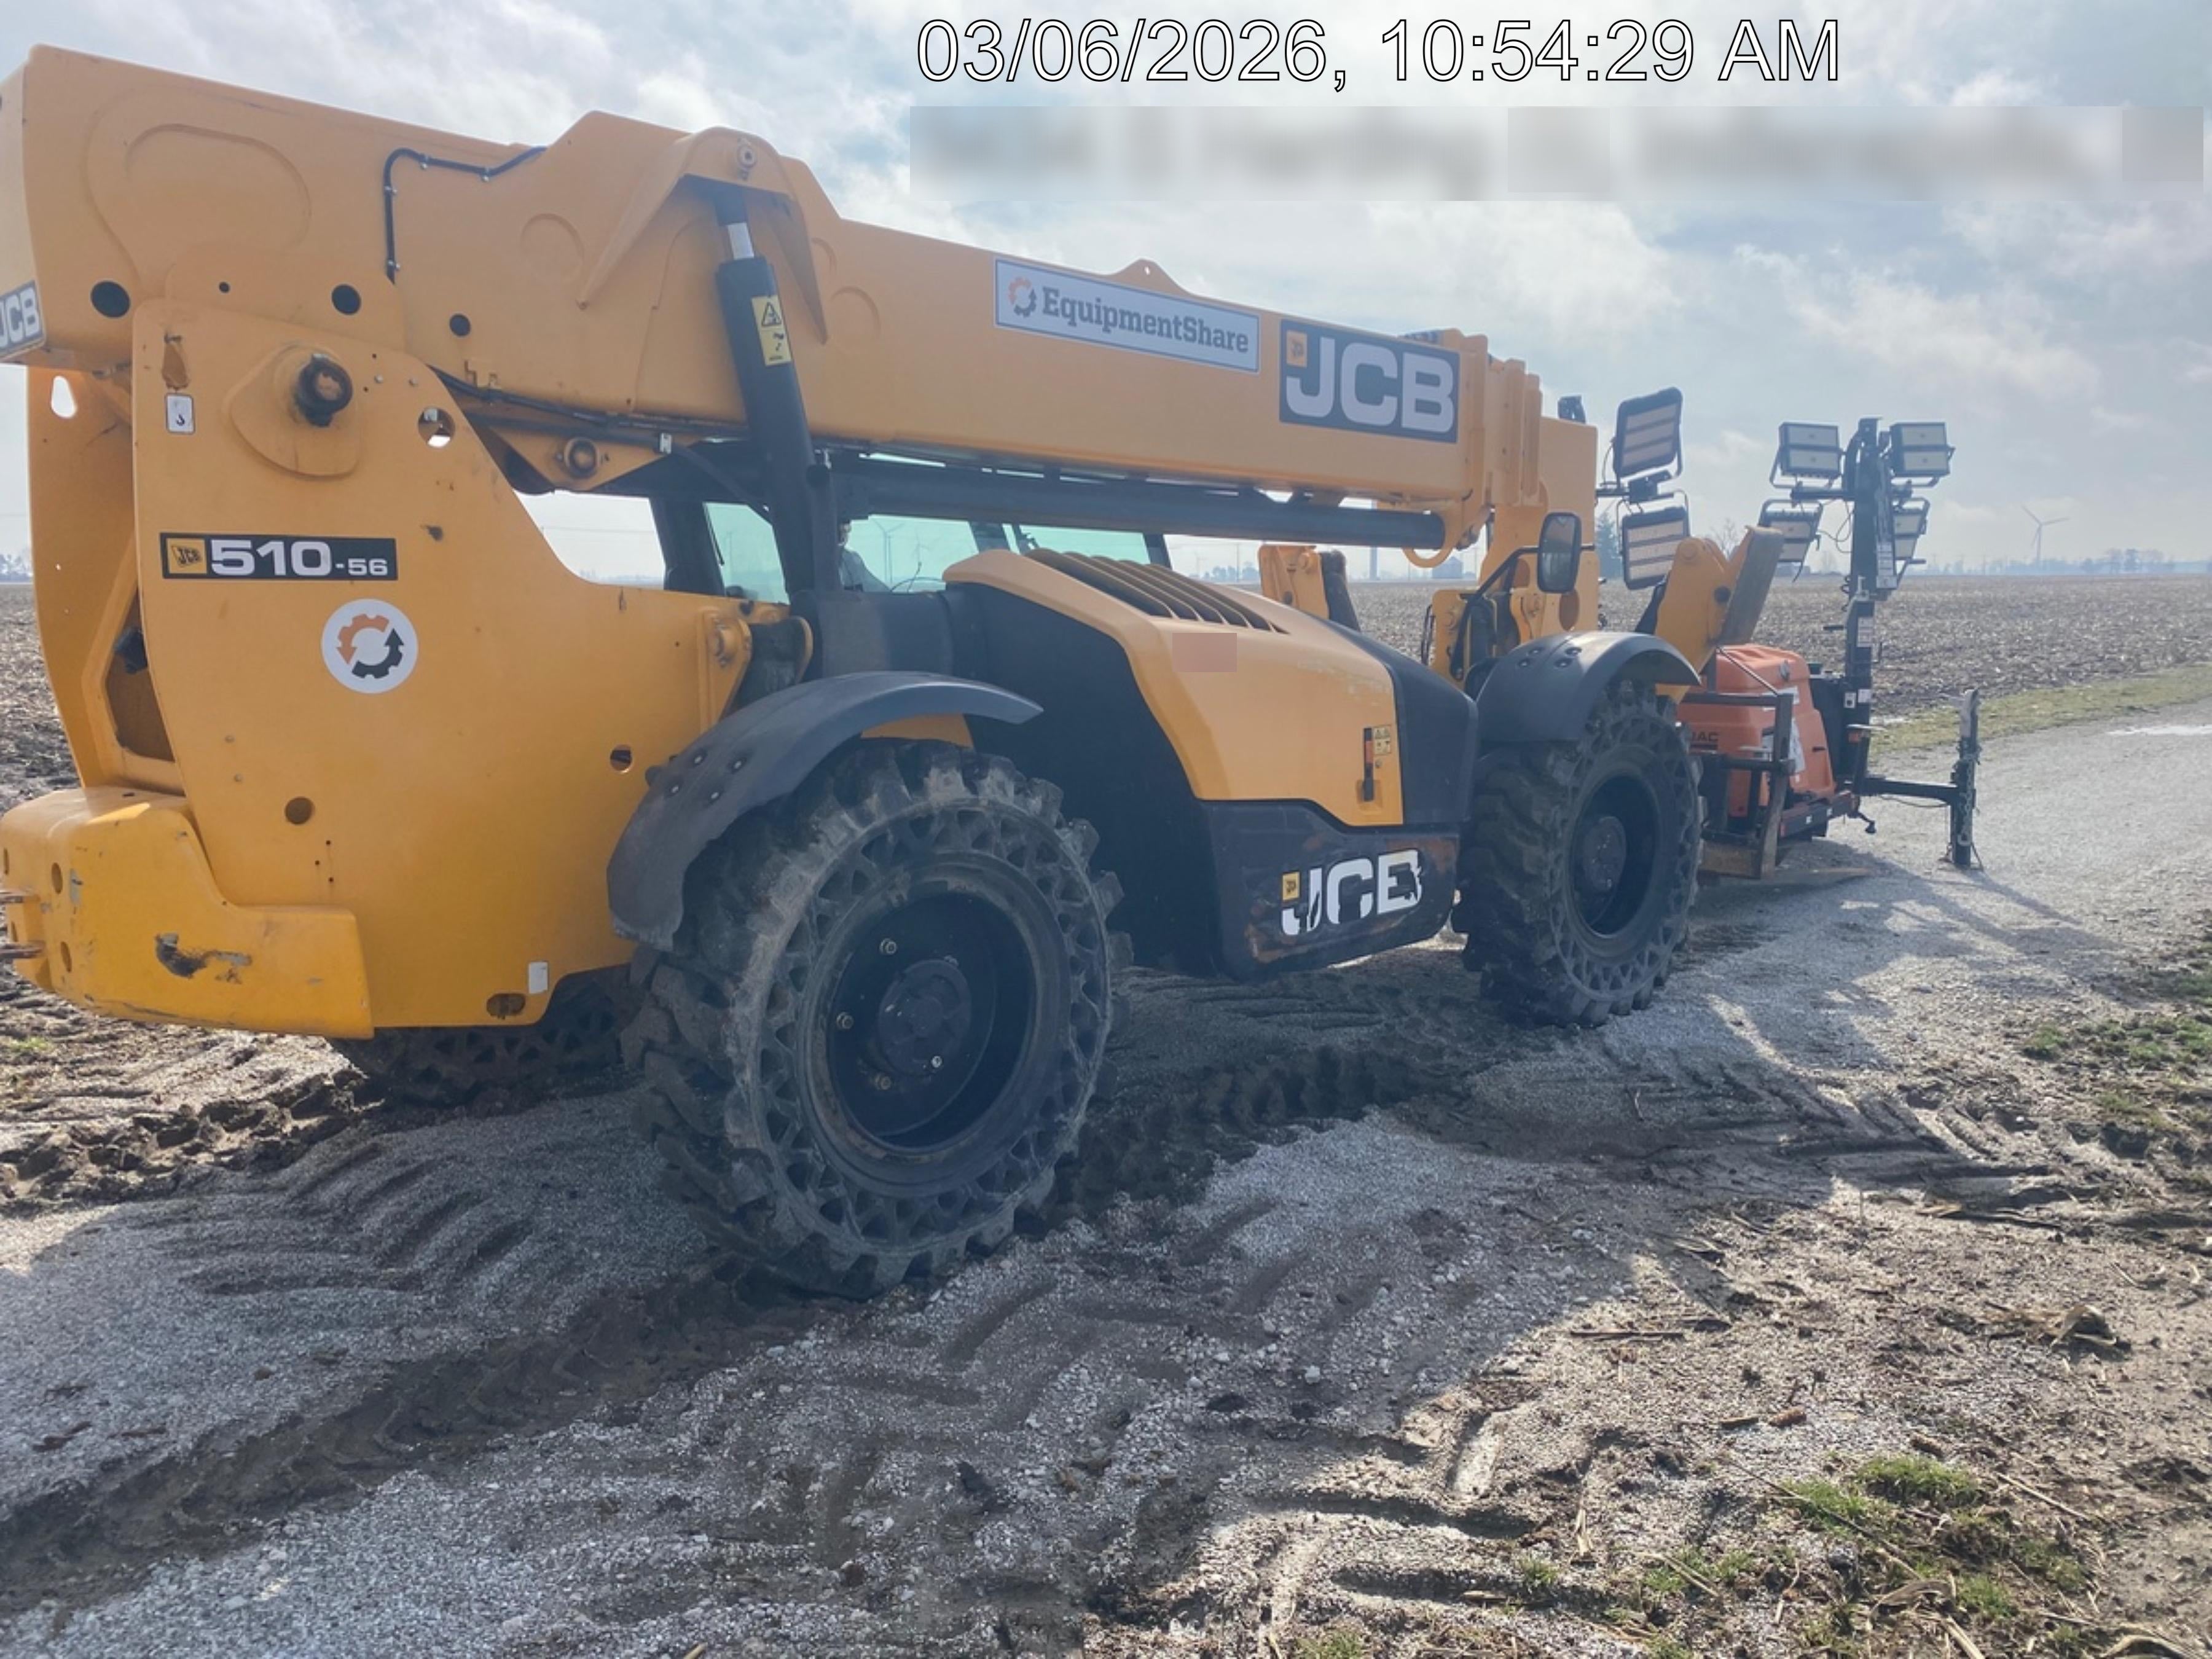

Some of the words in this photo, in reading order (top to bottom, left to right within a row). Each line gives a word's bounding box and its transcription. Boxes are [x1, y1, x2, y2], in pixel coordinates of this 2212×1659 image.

[1042, 285, 1249, 353] EquipmentShare
[1286, 336, 1454, 433] JCB
[211, 539, 388, 576] 510-56
[1282, 849, 1422, 936] JCB
